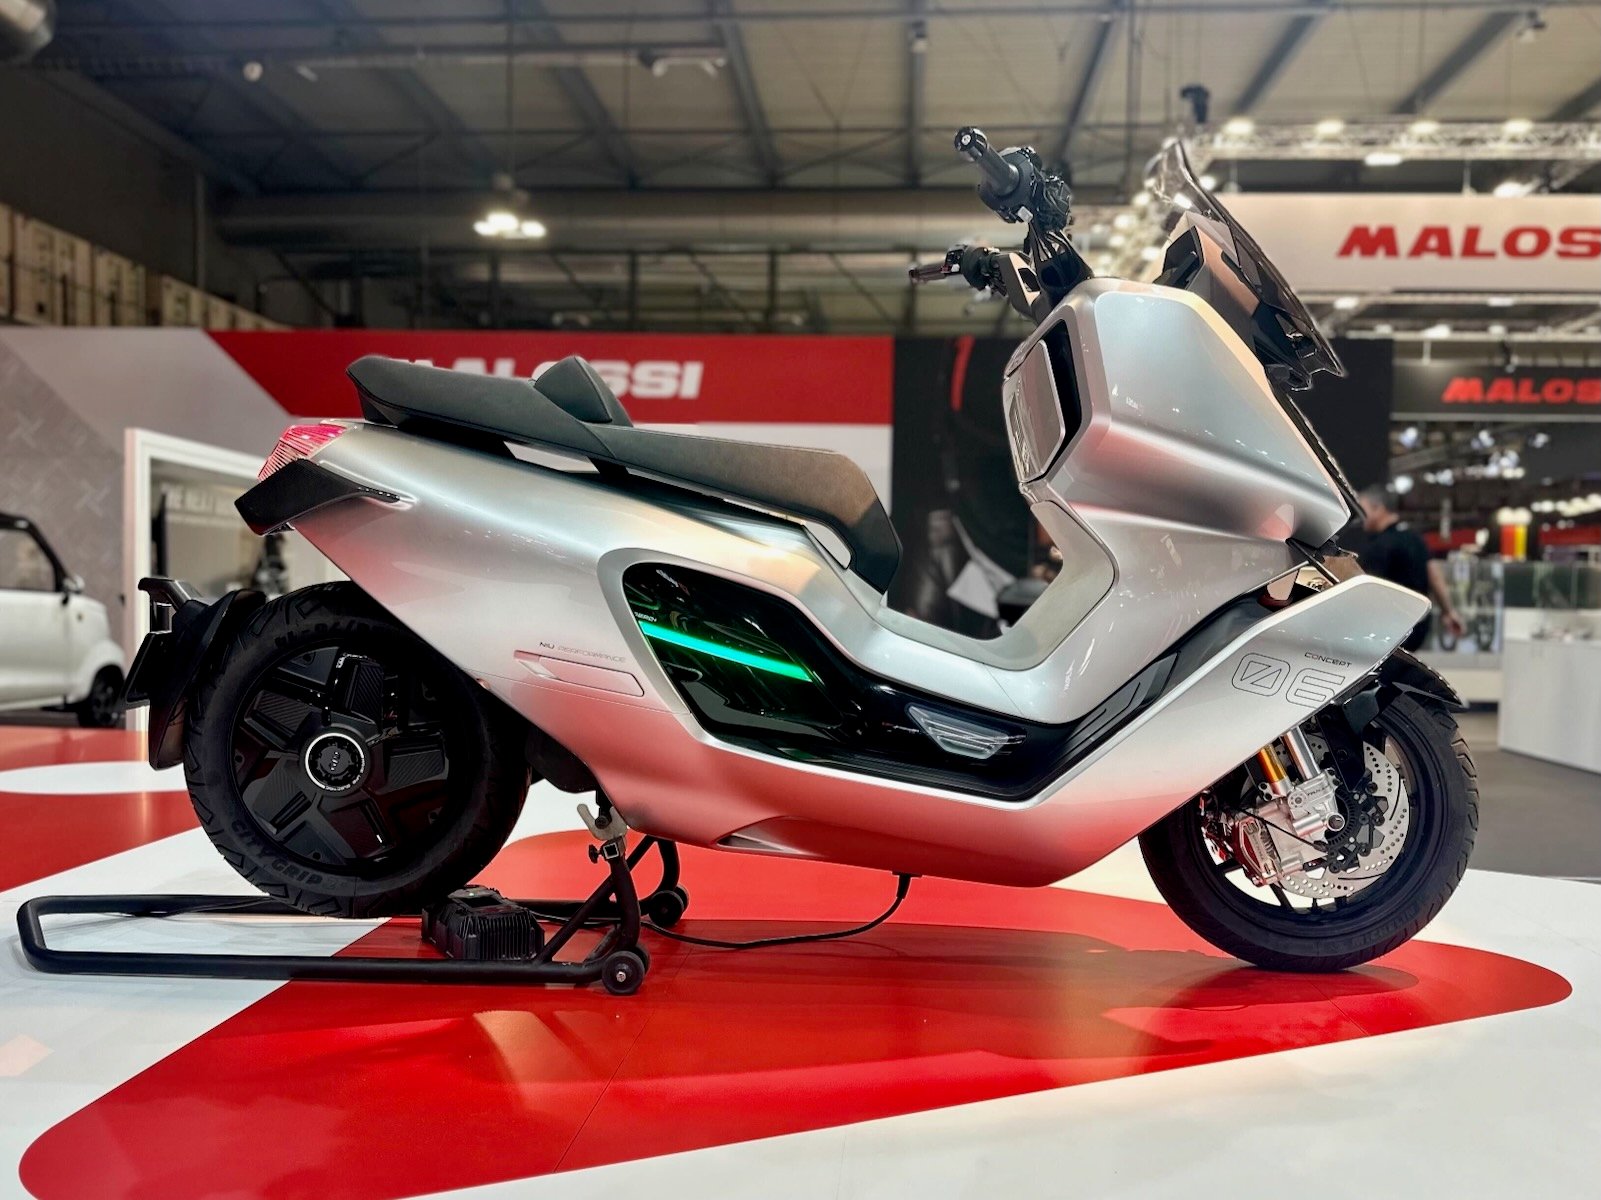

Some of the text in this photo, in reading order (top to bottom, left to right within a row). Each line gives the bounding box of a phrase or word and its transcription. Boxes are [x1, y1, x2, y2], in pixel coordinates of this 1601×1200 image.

[1337, 225, 1601, 259] MALOS
[1441, 376, 1601, 404] MALOS
[539, 641, 626, 663] NIU PERFORMANCE
[1304, 651, 1353, 668] CONCEPT
[1231, 652, 1346, 710] 06
[270, 858, 323, 885] GRIP
